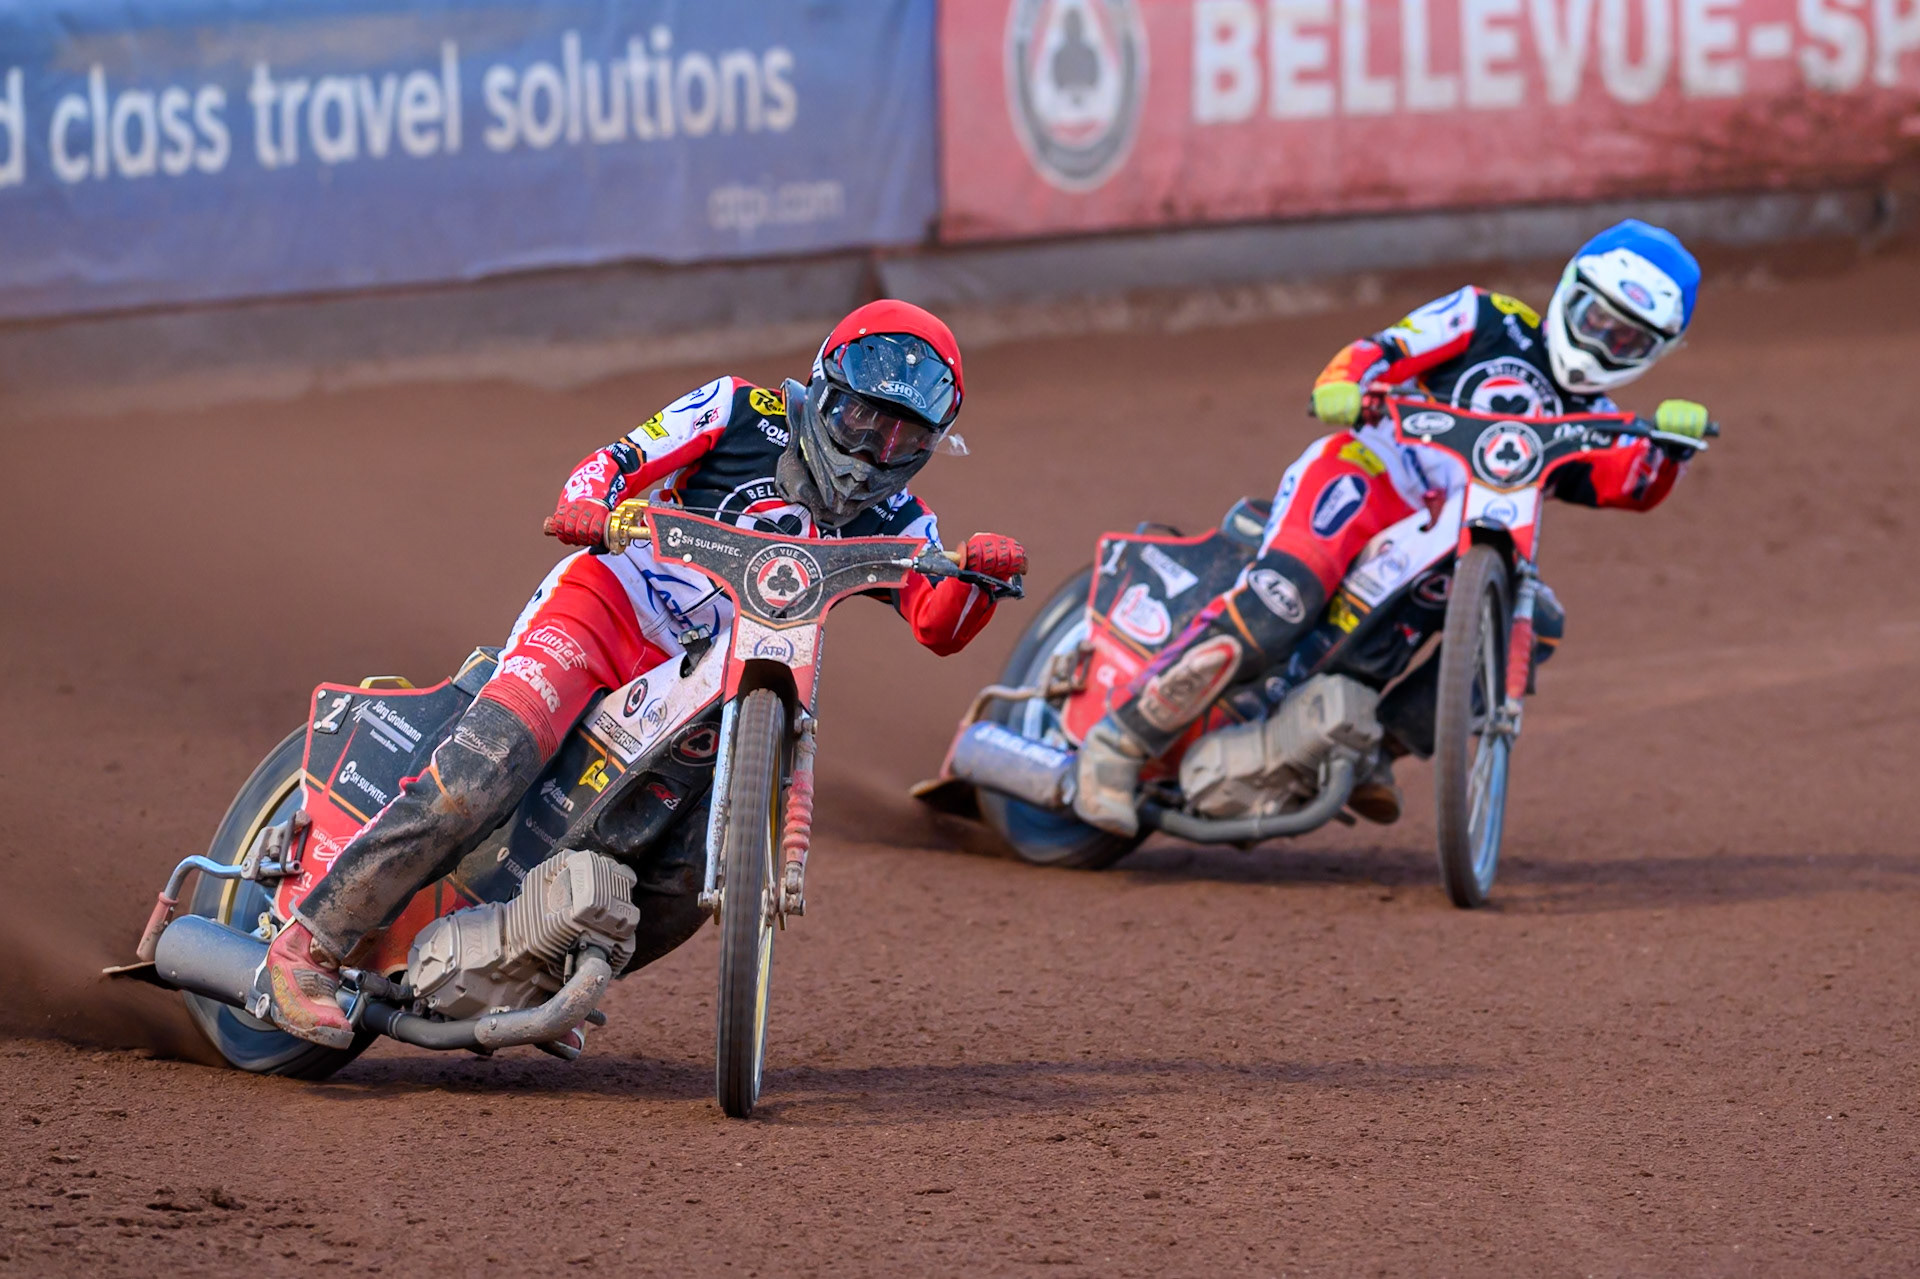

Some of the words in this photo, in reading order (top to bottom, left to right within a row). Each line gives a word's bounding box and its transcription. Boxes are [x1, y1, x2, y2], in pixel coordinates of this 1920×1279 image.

[51, 62, 231, 183] class
[249, 40, 461, 169] travel
[482, 24, 798, 151] solutions
[779, 548, 800, 558] VUE
[801, 557, 818, 579] ACES
[532, 630, 575, 657] Lüthje
[321, 698, 348, 729] 2
[372, 700, 389, 720] Jörg
[387, 710, 422, 742] Grohmann
[504, 859, 528, 880] TERM
